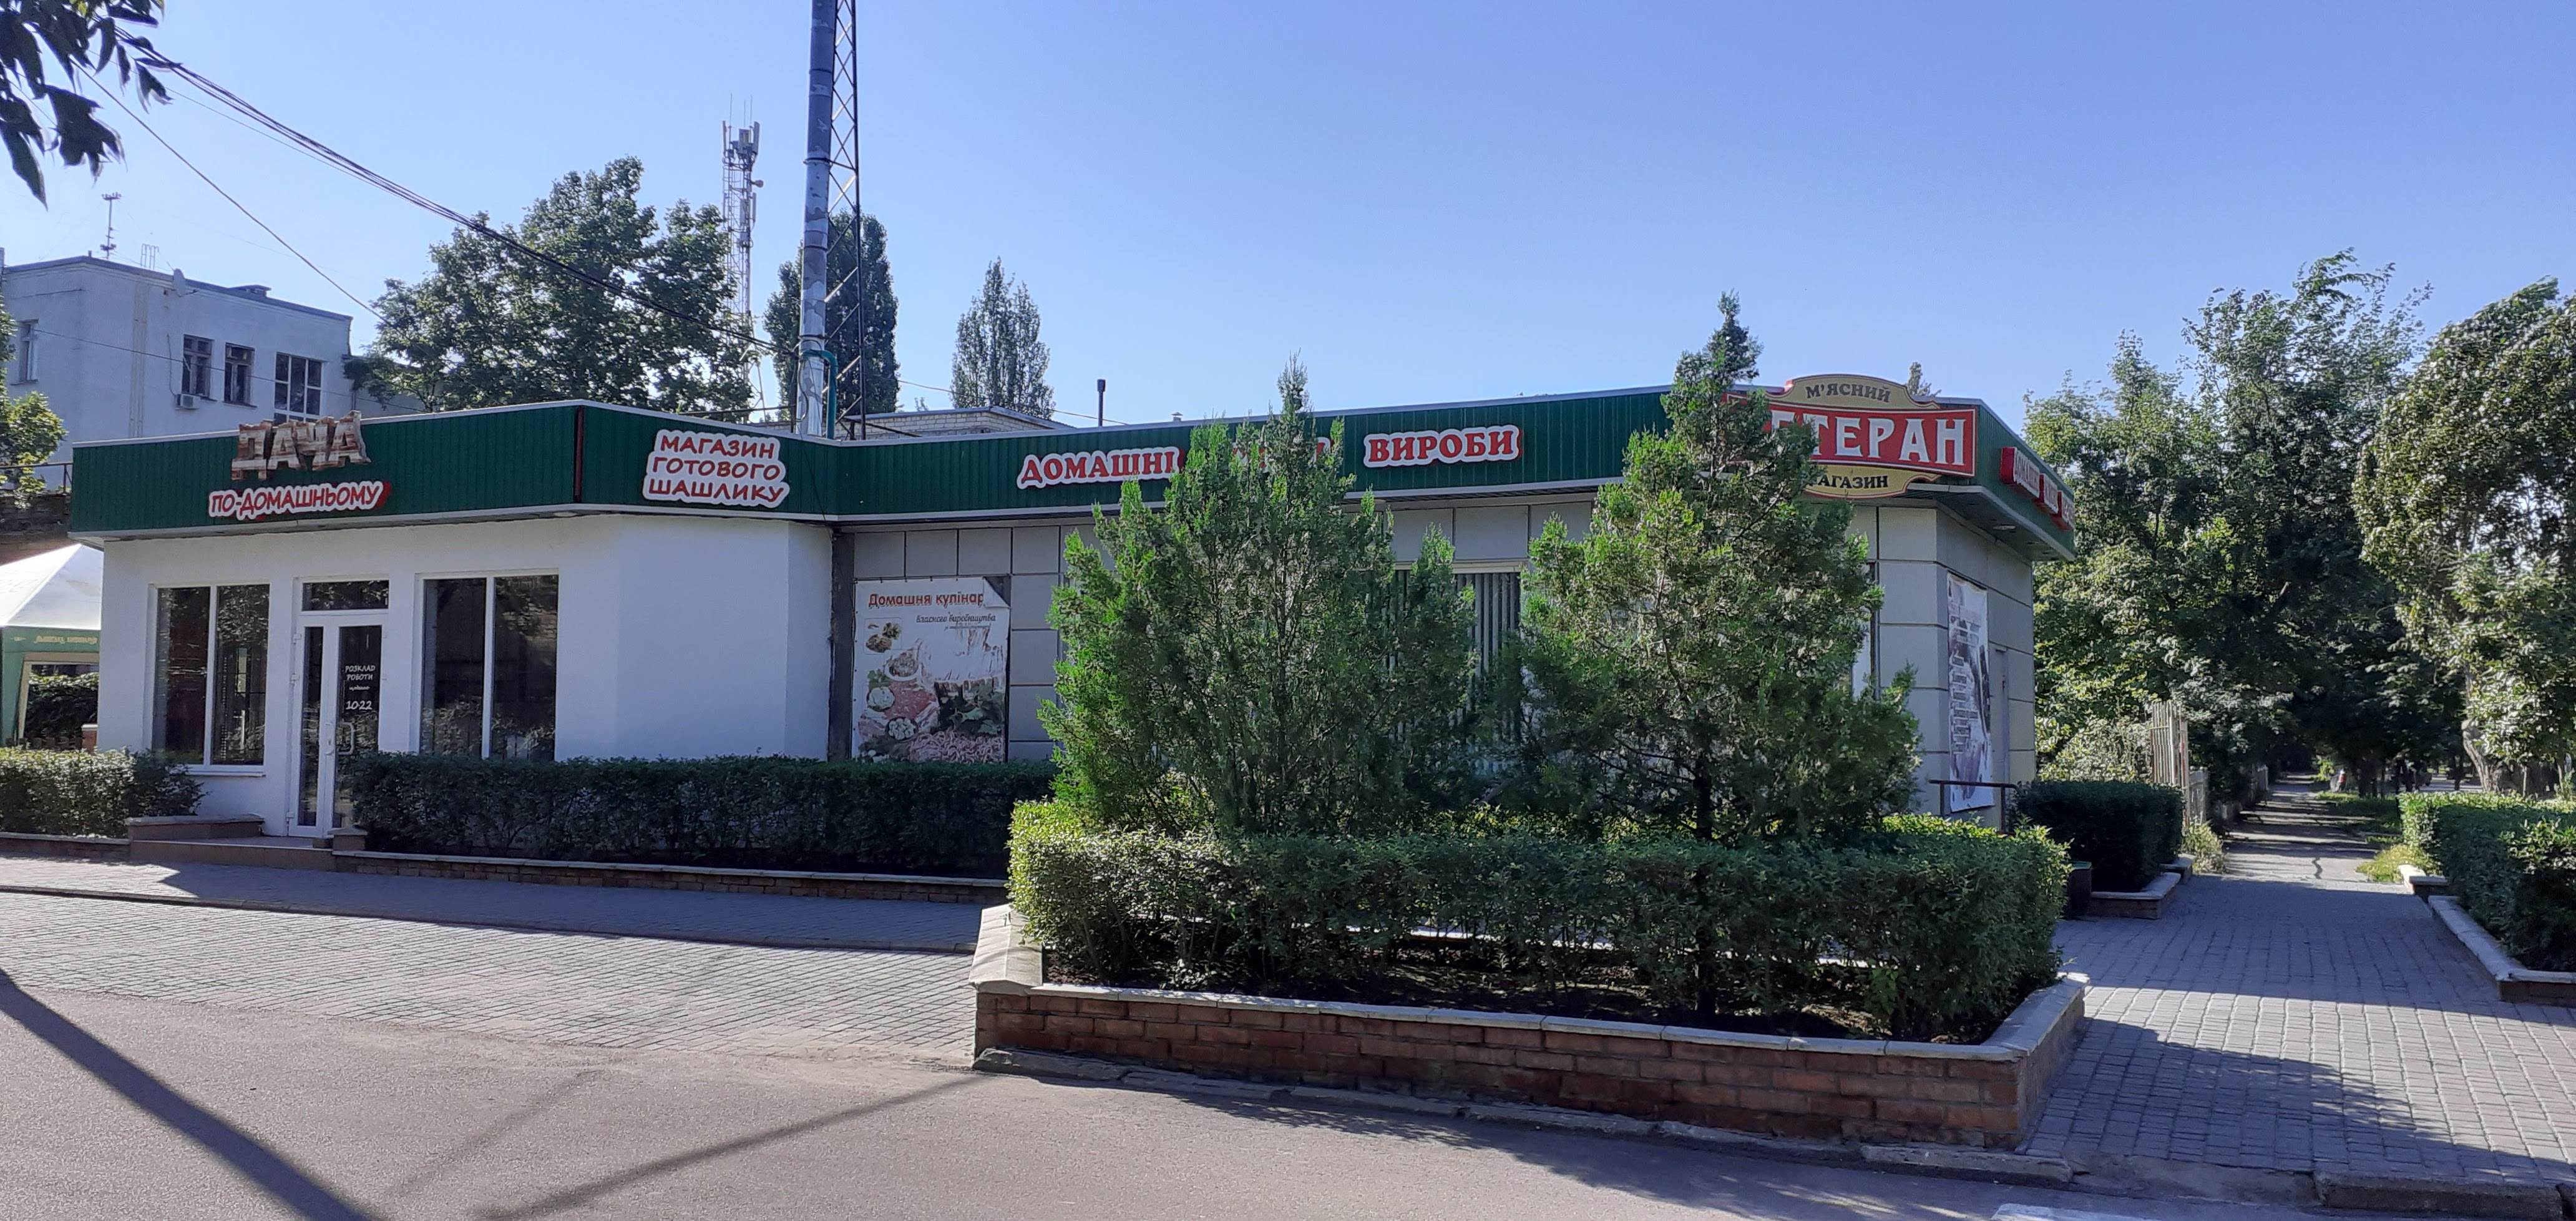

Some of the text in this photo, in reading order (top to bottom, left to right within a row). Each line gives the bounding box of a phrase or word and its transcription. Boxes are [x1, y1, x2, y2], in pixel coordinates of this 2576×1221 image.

[1805, 383, 1891, 403] М'ЯСНИЙ
[232, 410, 371, 480] ДАЧА
[660, 434, 775, 459] МАГАЗИН
[1771, 409, 1966, 466] ТЕРАН
[652, 456, 781, 481] ГОТОВОГО
[1021, 430, 1514, 484] ДОМАШНІ ВИРОБИ
[648, 478, 784, 503] ШАШЛИКУ
[1808, 475, 1889, 489] АГАЗИН
[210, 483, 381, 516] ПО-ДОМАШНЬОМУ
[868, 591, 984, 609] Домашня кулінар
[345, 665, 376, 674] РОЗКЛАД
